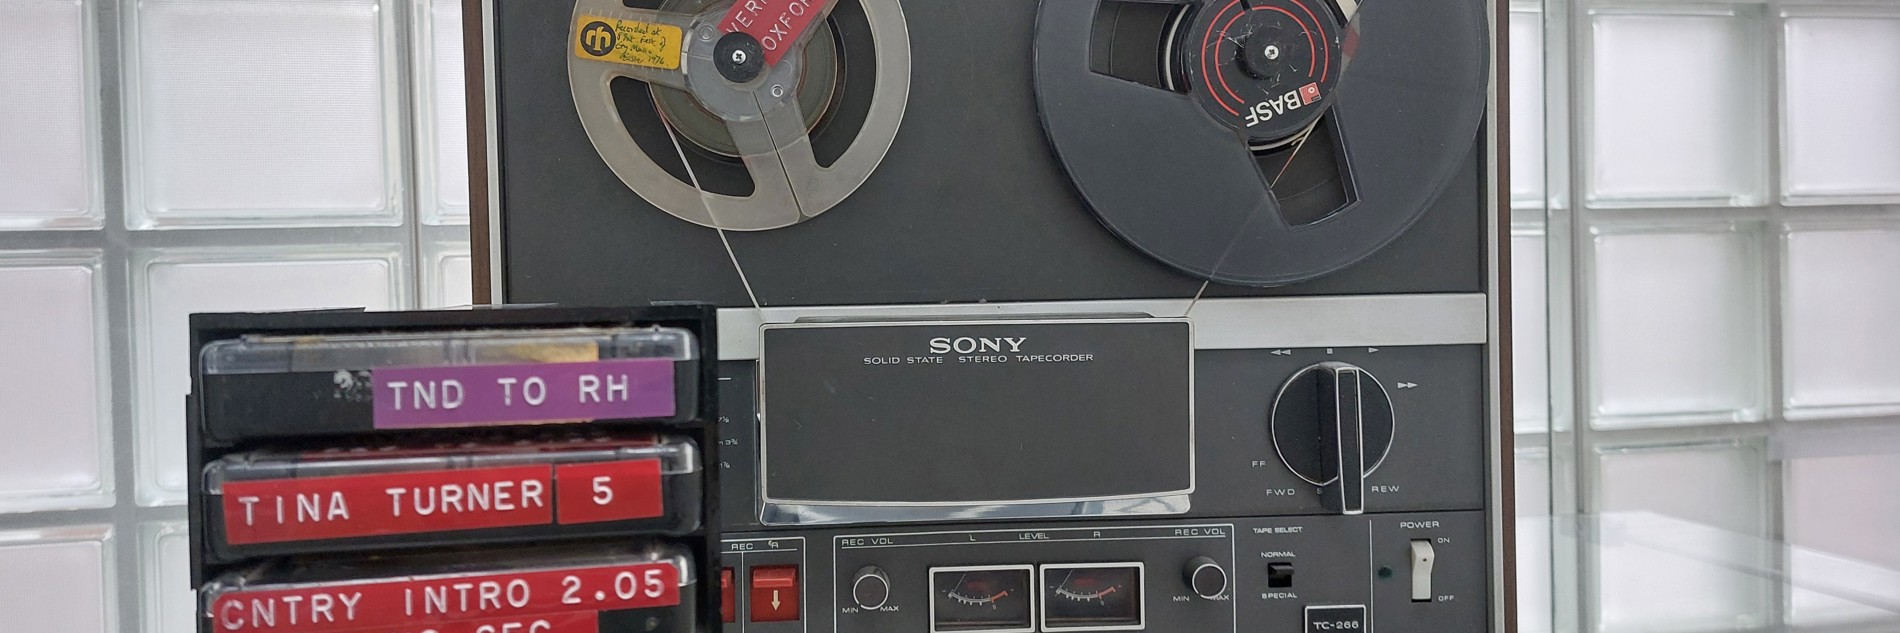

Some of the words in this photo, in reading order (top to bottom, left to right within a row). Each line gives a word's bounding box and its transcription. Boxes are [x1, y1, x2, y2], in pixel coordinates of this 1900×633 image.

[1245, 90, 1301, 127] BASF
[930, 337, 1027, 354] SONY
[863, 357, 900, 365] SOLID
[906, 356, 943, 364] STATE
[958, 355, 1008, 363] STEREO
[1015, 354, 1094, 362] TAPECORDER
[387, 378, 464, 411] TND
[497, 377, 547, 407] TO
[578, 374, 629, 402] RH
[1252, 460, 1266, 468] FF
[592, 476, 613, 505] 5
[1266, 488, 1296, 496] FWD
[1371, 485, 1400, 493] REW
[237, 491, 350, 526] TINA
[385, 479, 545, 516] TURNER
[1400, 520, 1440, 529] POWER
[1019, 532, 1050, 540] LEVEL
[1174, 528, 1198, 536] REC
[1203, 527, 1226, 535] VOL
[841, 538, 865, 546] REC
[870, 537, 894, 545] VOL
[220, 592, 363, 631] CNTRY
[404, 578, 531, 617] INTRO
[560, 568, 666, 605] 2.05
[842, 606, 859, 614] MIN
[879, 605, 900, 613] MAX
[1313, 620, 1359, 630] TC-266
